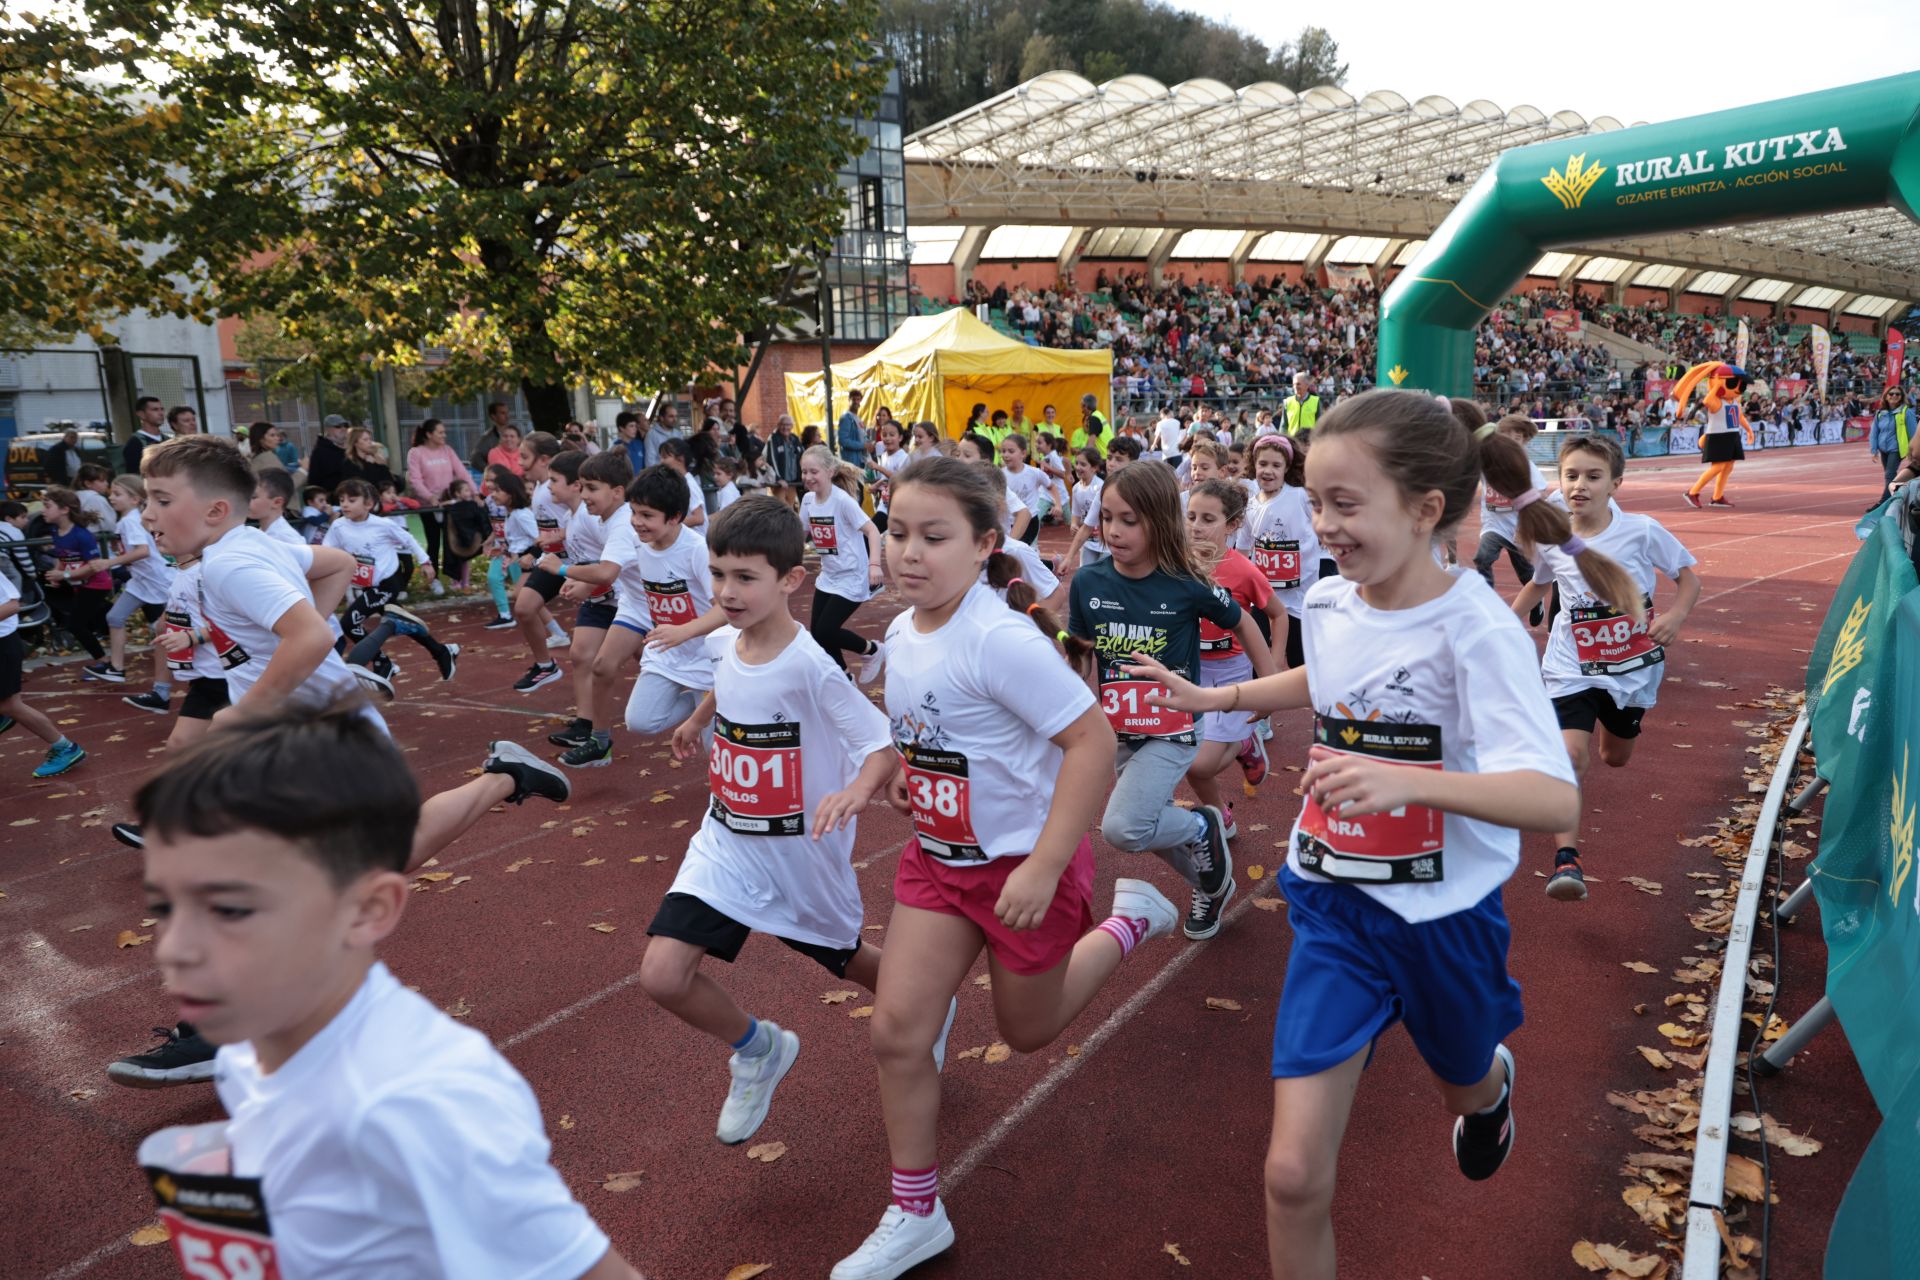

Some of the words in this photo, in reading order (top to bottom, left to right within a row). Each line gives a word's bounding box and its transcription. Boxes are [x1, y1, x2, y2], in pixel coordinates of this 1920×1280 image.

[1615, 150, 1715, 187] RURAL
[1723, 126, 1848, 169] KUTXA
[1615, 188, 1668, 206] GIZARTE
[1670, 180, 1727, 198] EKINTZA
[1735, 169, 1790, 189] ACCIÓN
[1792, 161, 1847, 179] SOCIAL
[8, 447, 40, 464] DYA
[1255, 551, 1295, 569] 3013
[650, 596, 687, 614] 240
[1108, 621, 1126, 638] NO
[1128, 623, 1153, 641] HAY
[1574, 620, 1648, 647] 3484
[1095, 635, 1168, 653] EXCUSAS
[1600, 643, 1632, 656] ENDIKA
[1124, 717, 1161, 726] BRUNO
[1362, 733, 1392, 744] RURAL
[1393, 735, 1429, 745] KUTXA
[710, 741, 785, 788] 3001
